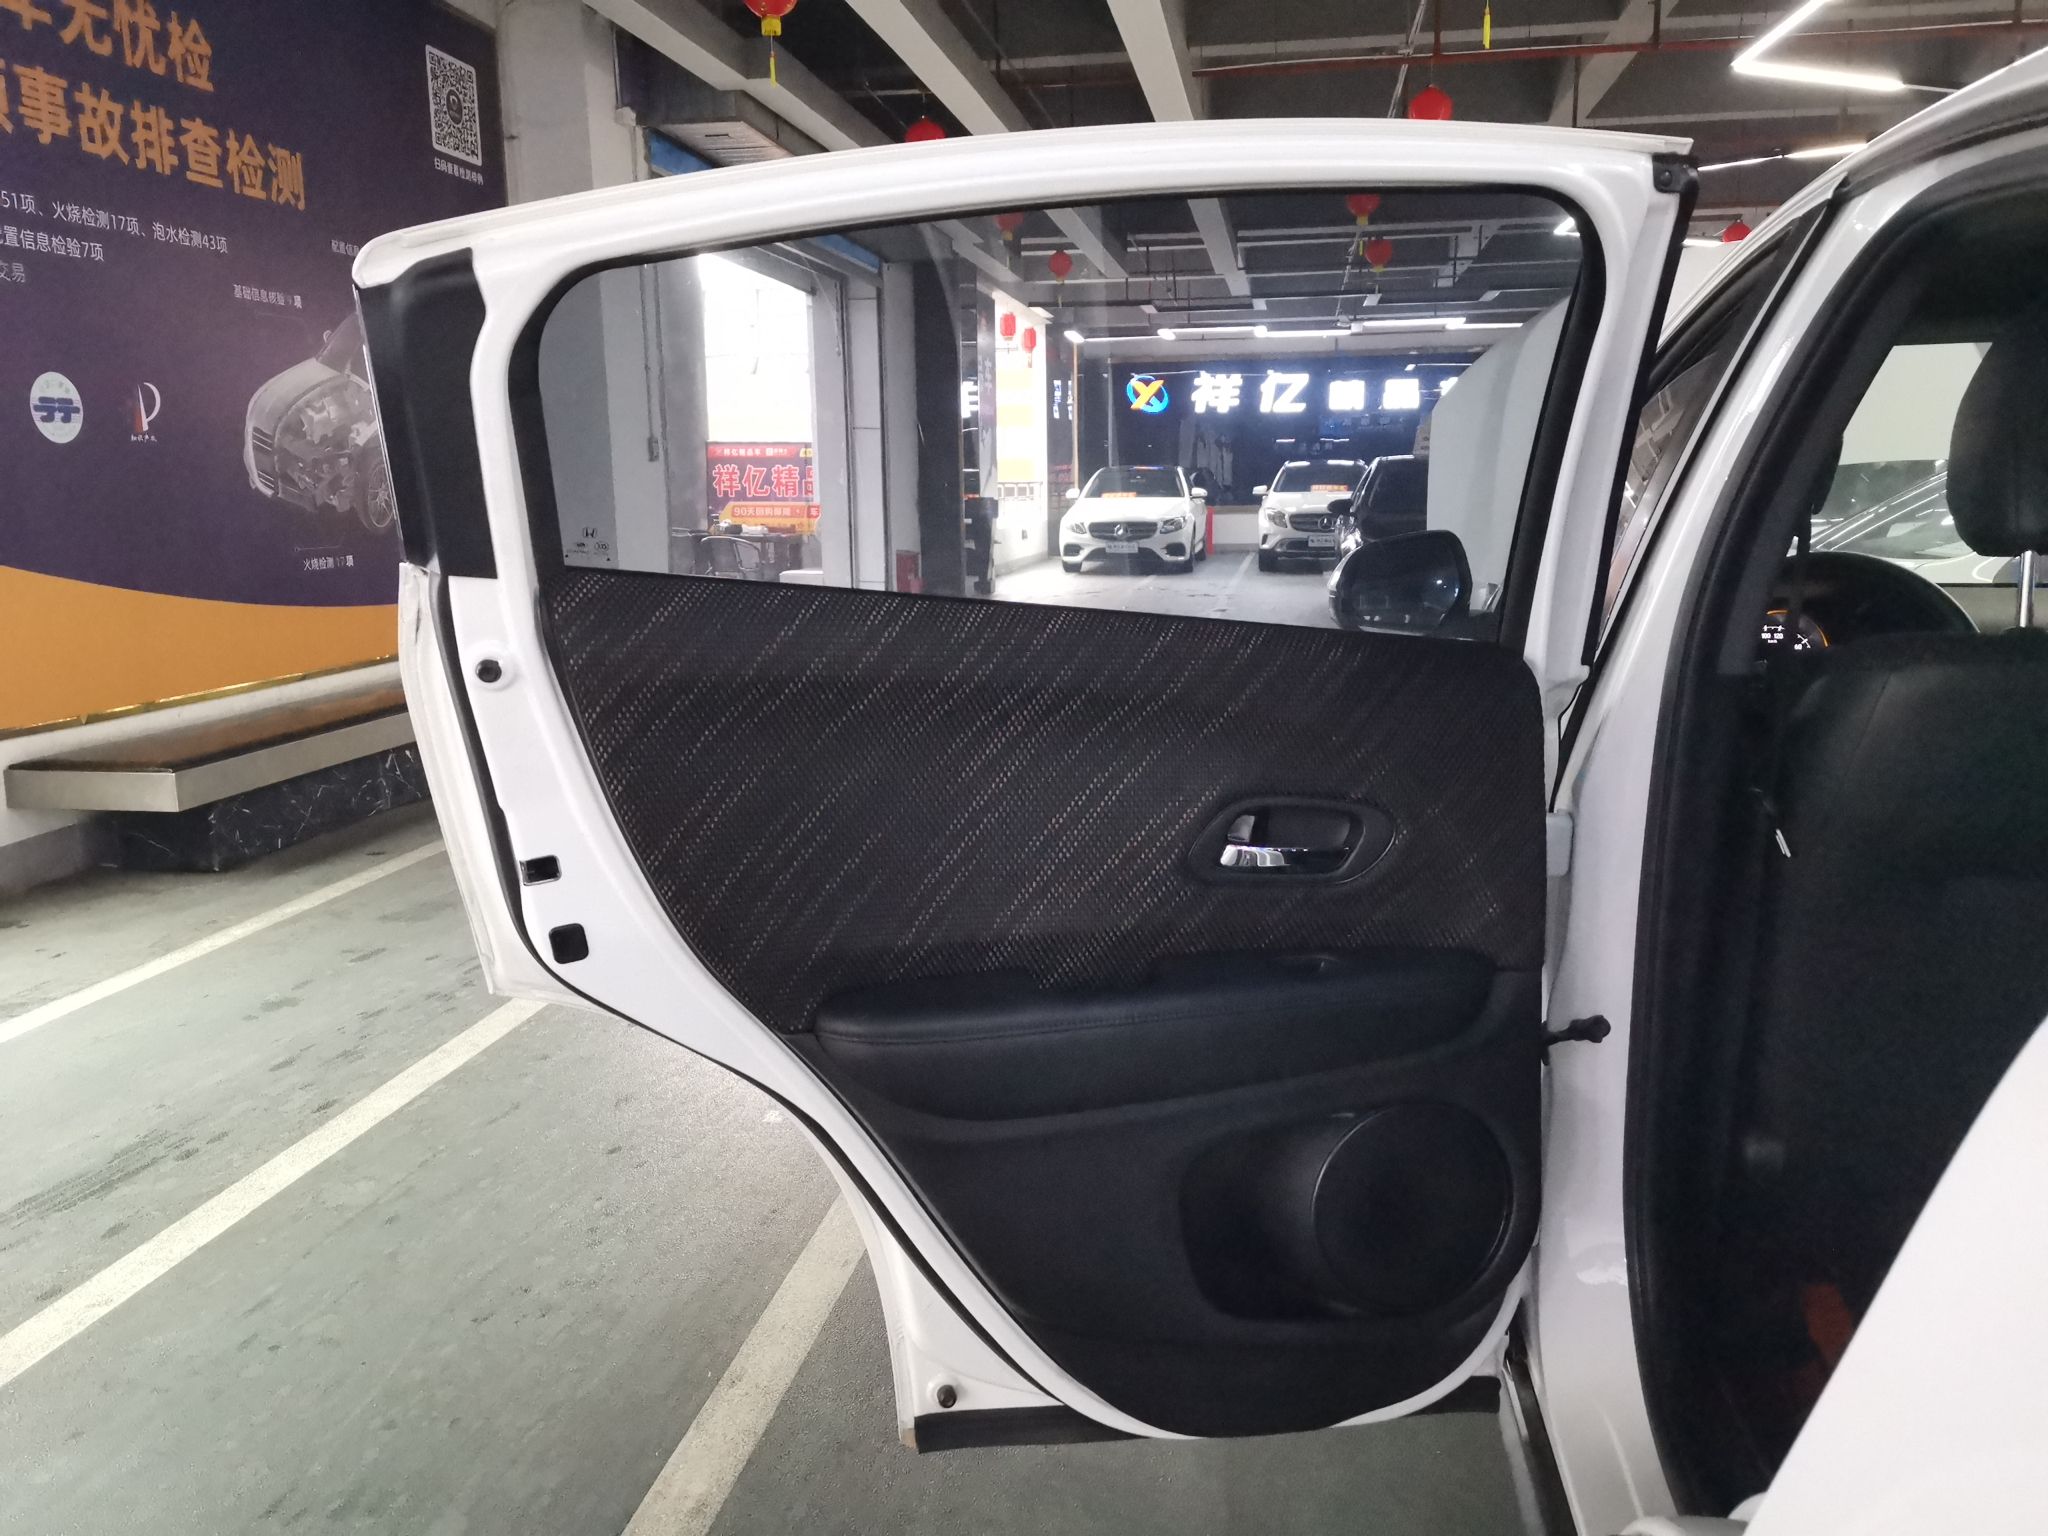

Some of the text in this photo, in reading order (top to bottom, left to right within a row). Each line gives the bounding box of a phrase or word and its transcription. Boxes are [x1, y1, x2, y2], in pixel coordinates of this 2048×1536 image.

[0, 57, 305, 210] 事故排查检测
